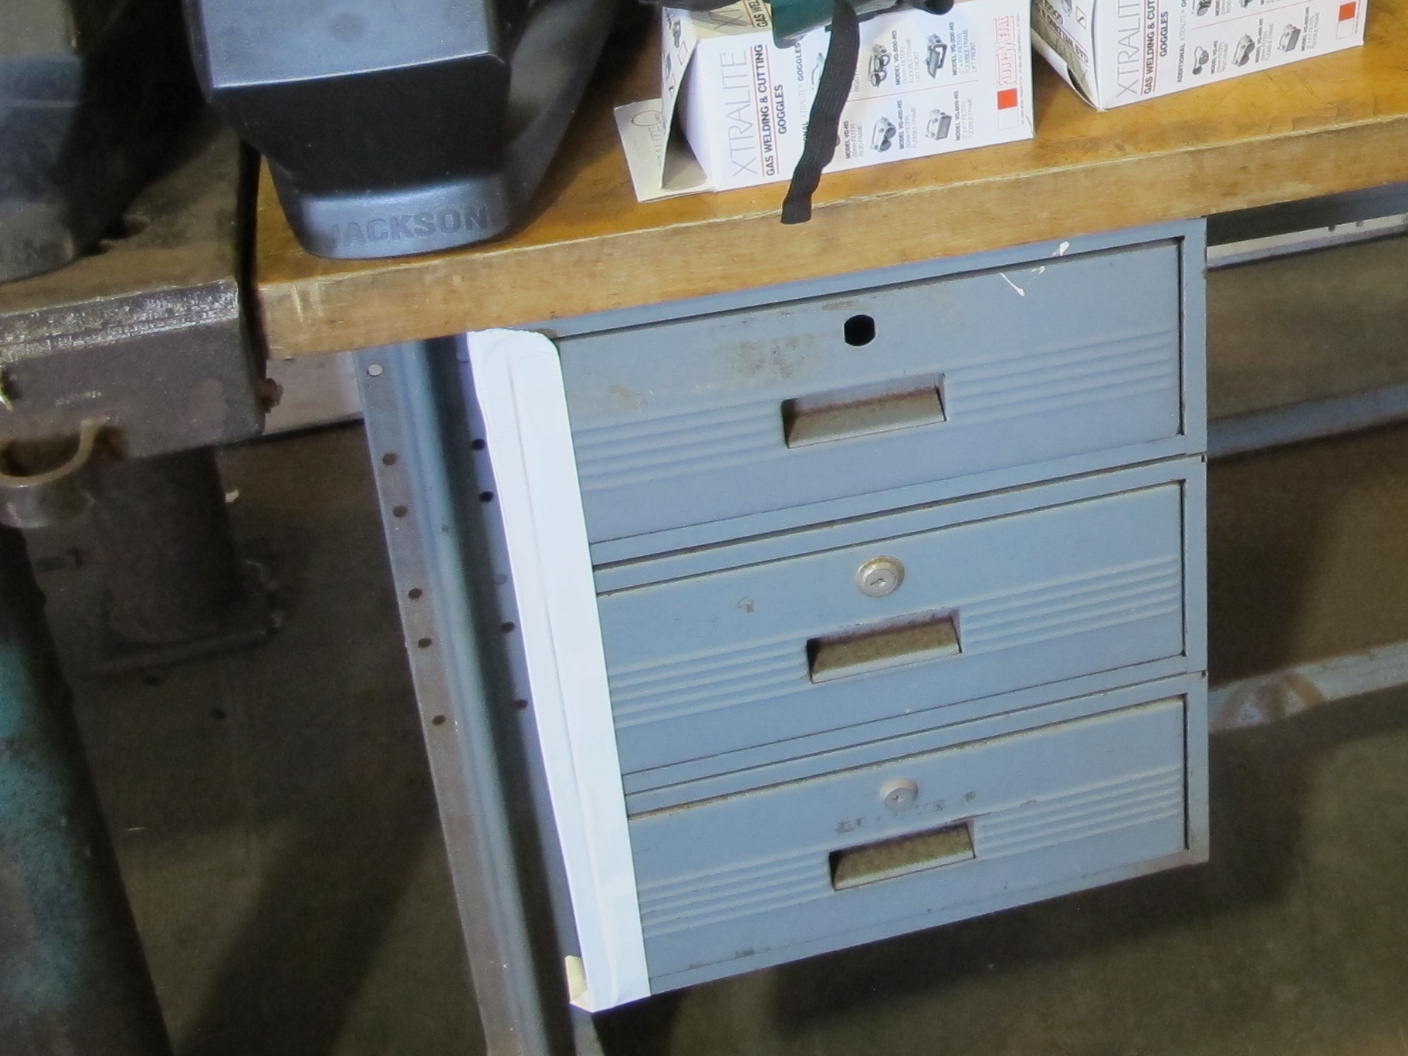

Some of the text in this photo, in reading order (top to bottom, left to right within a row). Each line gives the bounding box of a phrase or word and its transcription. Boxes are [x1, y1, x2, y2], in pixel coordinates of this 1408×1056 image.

[1145, 30, 1155, 77] WELDING
[1159, 11, 1169, 58] GOGGLES
[753, 43, 767, 94] CUTTING
[1143, 77, 1153, 95] GAS
[720, 49, 759, 177] XTRALITE
[759, 105, 773, 154] WELDING
[773, 84, 787, 135] GOGGLES
[765, 156, 776, 176] GAS
[326, 204, 489, 250] JACKSON
